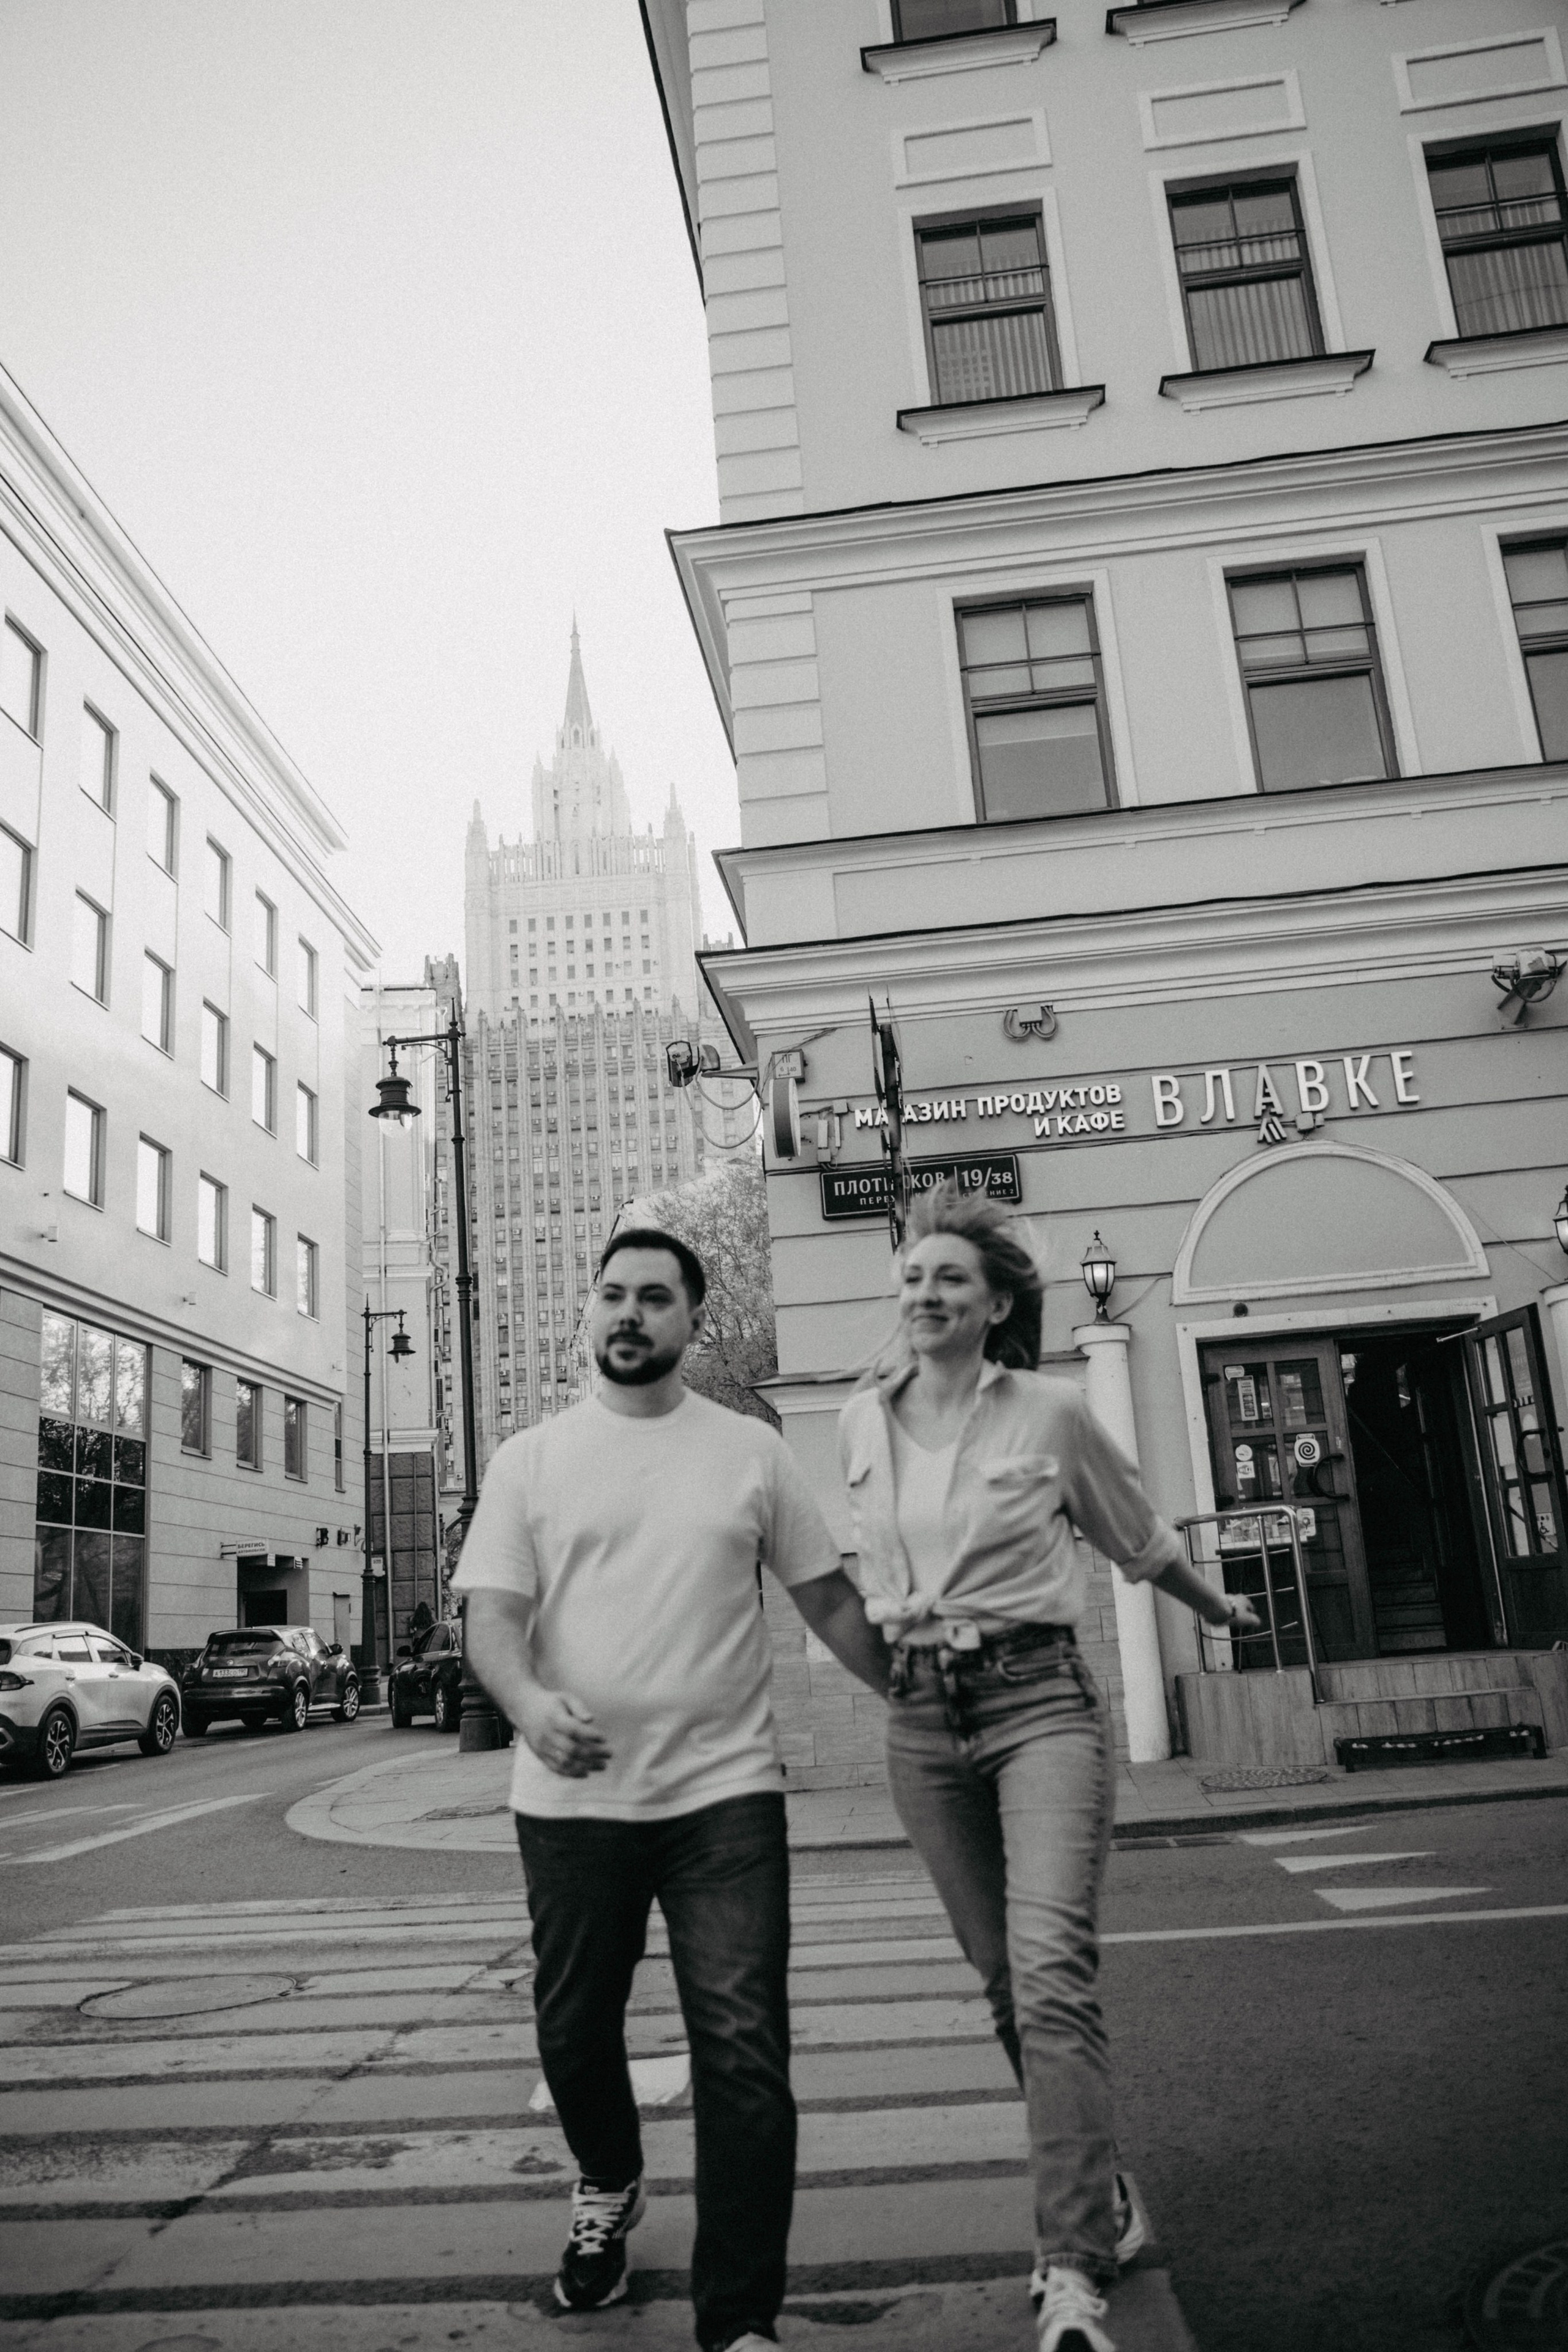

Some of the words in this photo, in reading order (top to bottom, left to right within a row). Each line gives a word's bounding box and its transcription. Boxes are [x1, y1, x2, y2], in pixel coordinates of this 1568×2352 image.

[854, 1099, 967, 1128] МААЗИН
[978, 1084, 1121, 1116] ПРОДУКТОВ
[1034, 1118, 1050, 1137] И
[1057, 1110, 1125, 1135] КАФЕ
[834, 1172, 945, 1196] ПЛОТКОВ
[961, 1167, 1013, 1187] 19/38
